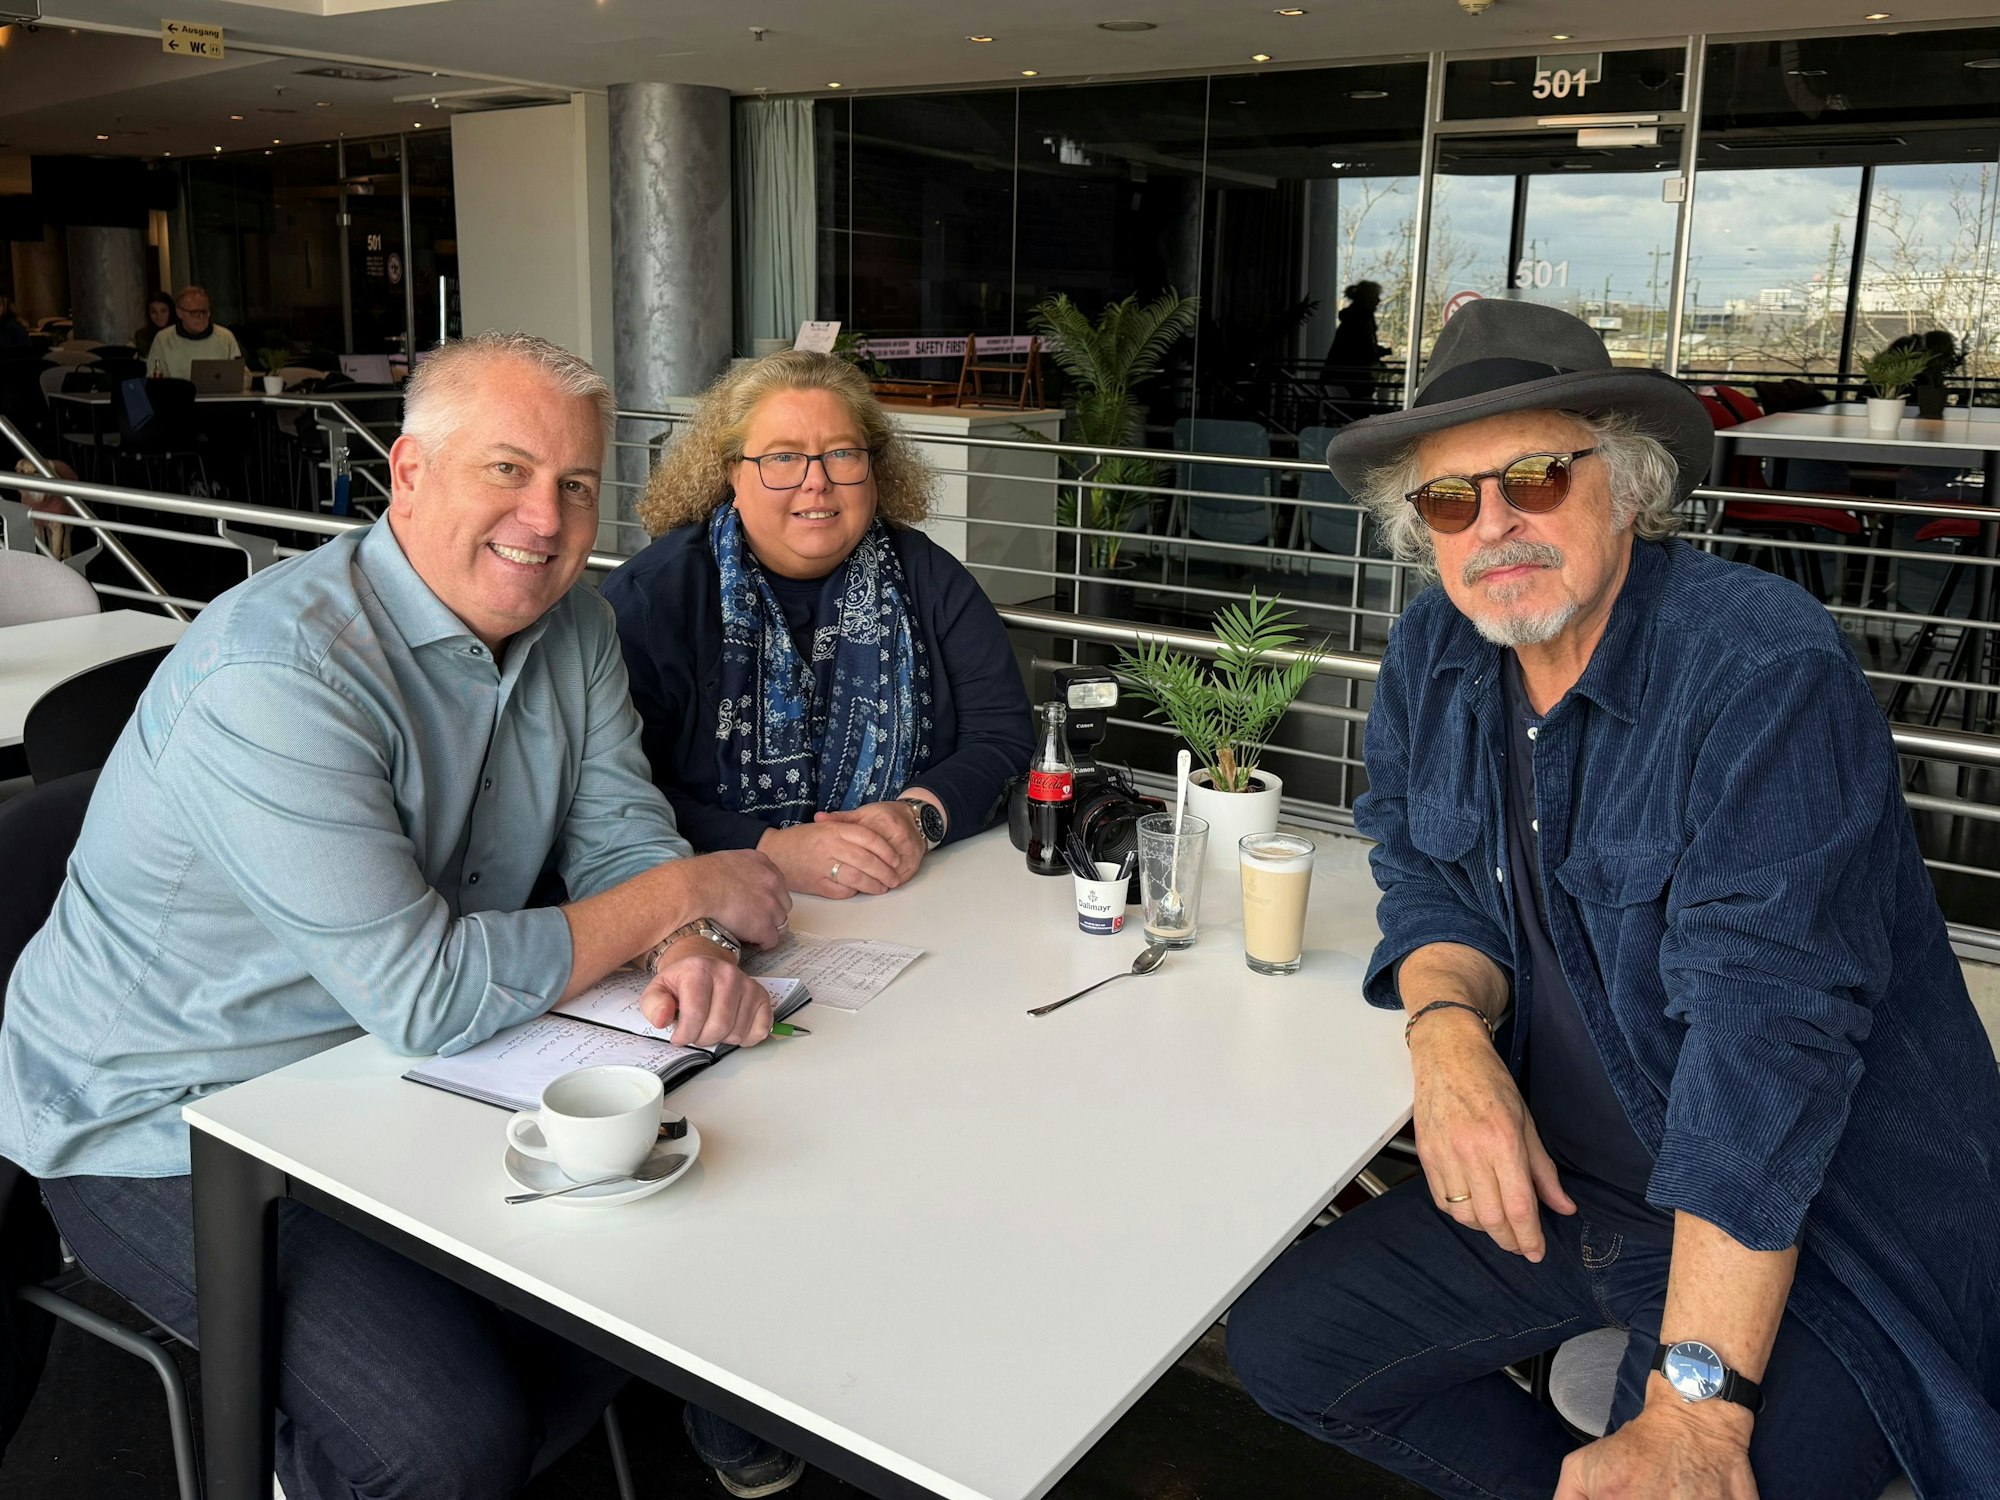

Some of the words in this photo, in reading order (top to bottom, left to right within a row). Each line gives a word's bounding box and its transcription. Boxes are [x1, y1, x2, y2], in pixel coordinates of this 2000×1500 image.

[181, 25, 219, 39] Ausgang
[190, 41, 207, 54] WC
[1532, 68, 1587, 99] 501
[367, 234, 382, 251] 501
[1514, 259, 1569, 289] 501
[915, 340, 944, 355] SAFETY
[1078, 898, 1111, 912] Dallmayr
